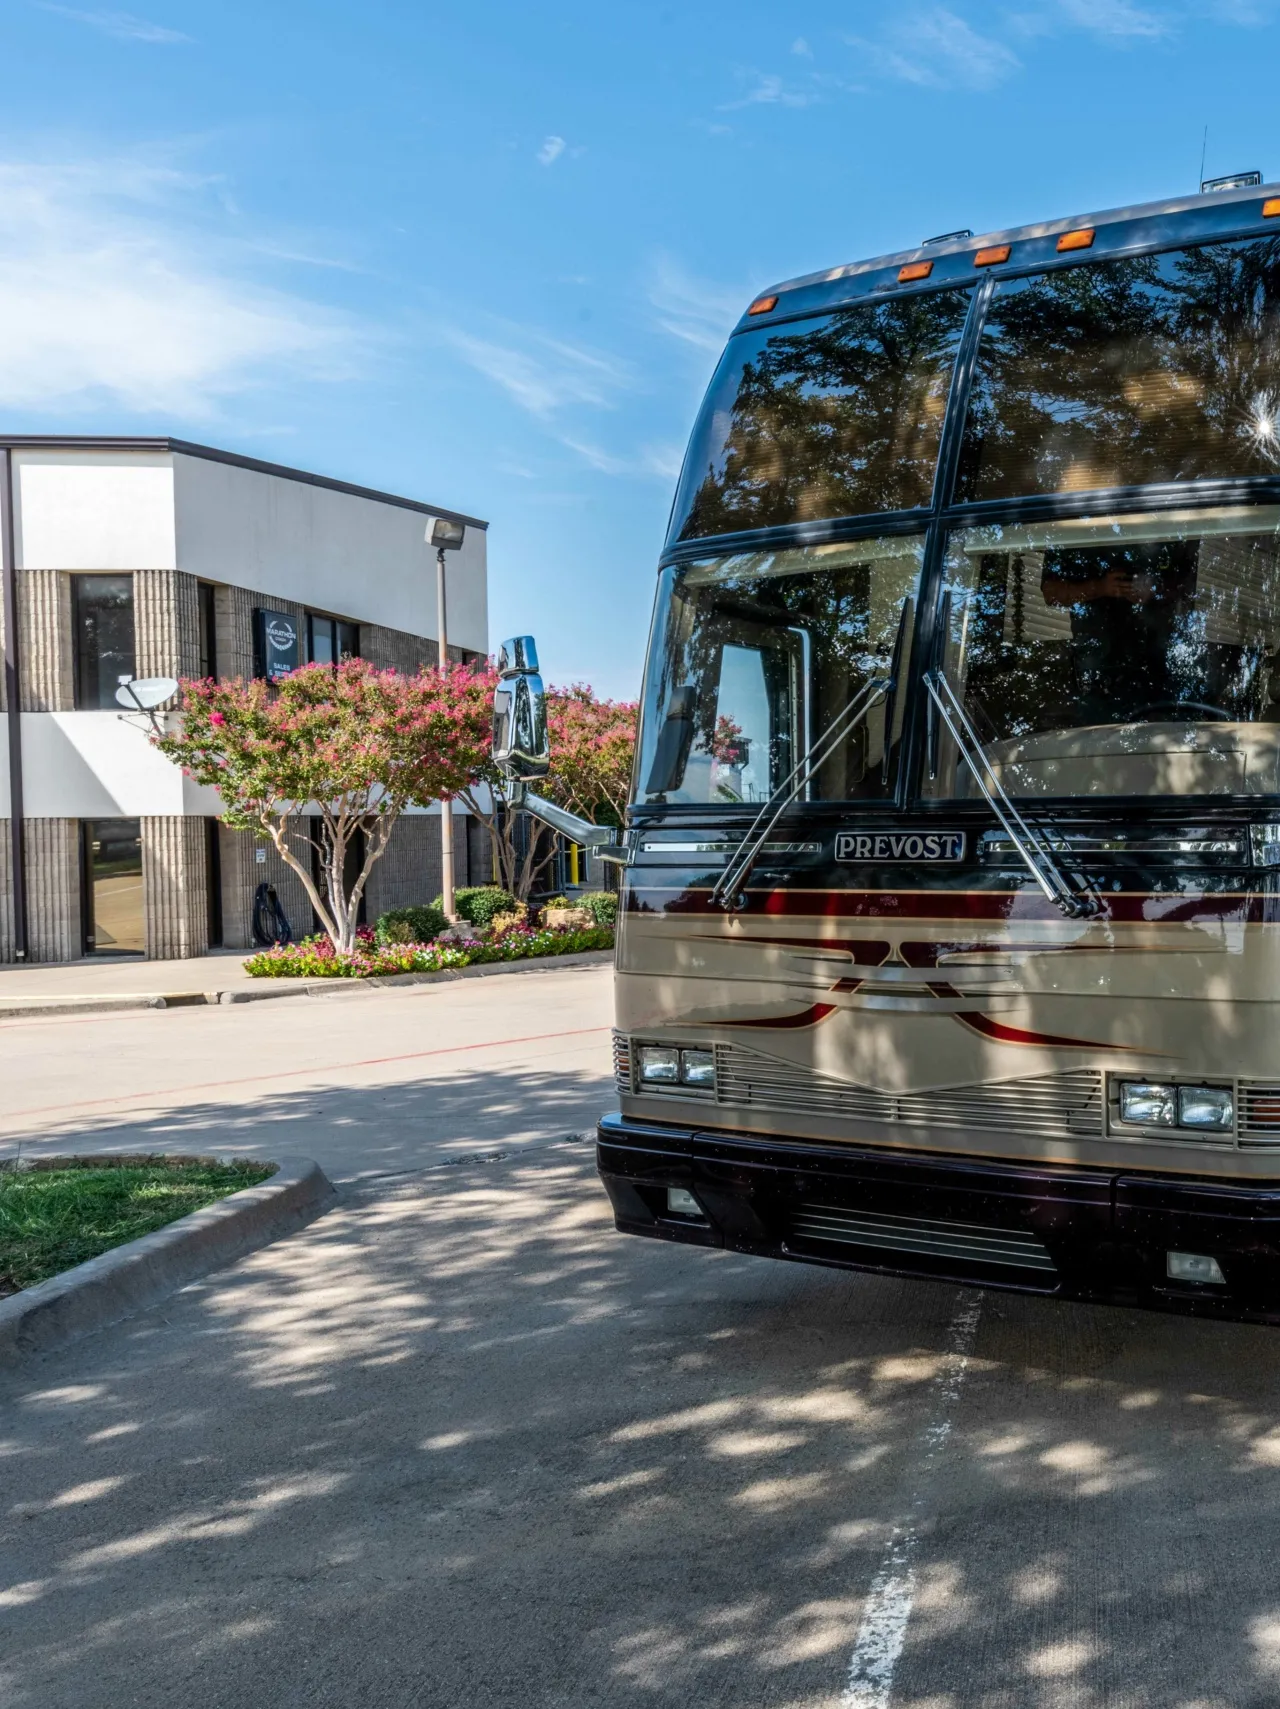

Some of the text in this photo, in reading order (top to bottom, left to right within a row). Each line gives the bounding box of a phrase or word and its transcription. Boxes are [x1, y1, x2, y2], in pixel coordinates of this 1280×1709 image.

[266, 628, 296, 639] MARATHON
[273, 663, 290, 671] SALES
[838, 835, 960, 859] PREVOST
